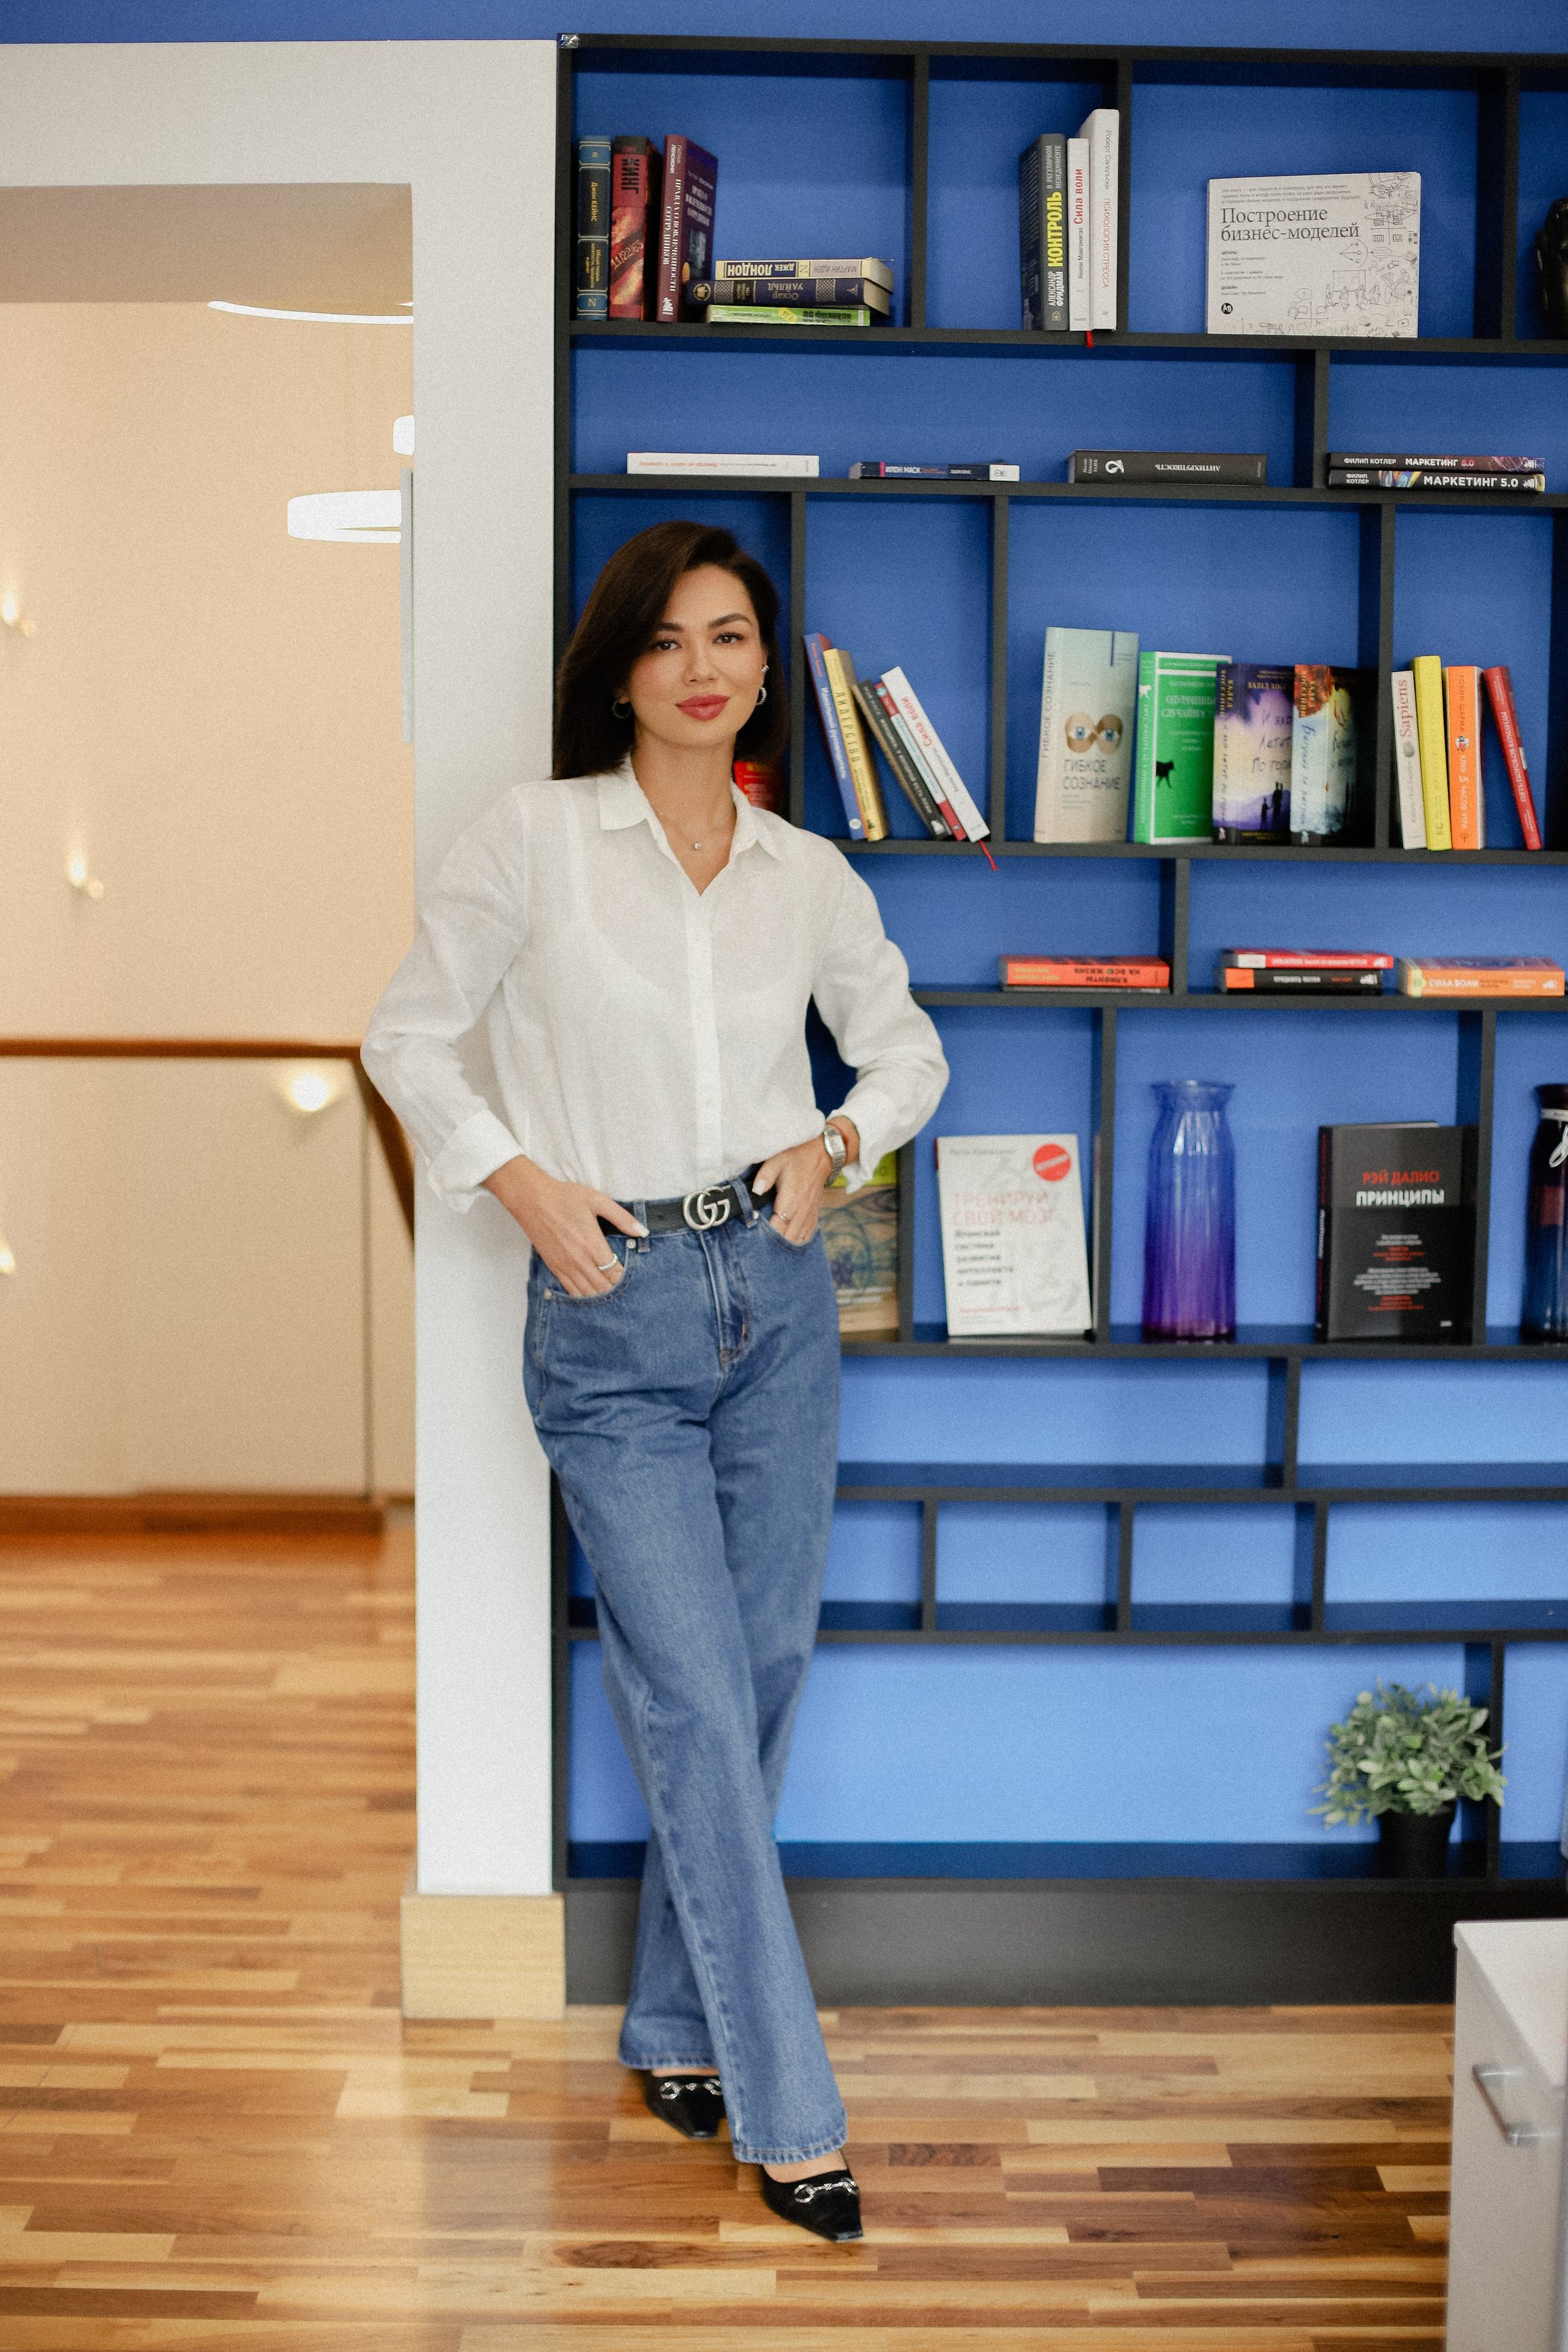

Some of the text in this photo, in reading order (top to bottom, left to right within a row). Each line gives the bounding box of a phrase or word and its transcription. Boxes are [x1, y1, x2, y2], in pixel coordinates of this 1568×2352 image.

[621, 159, 639, 194] КИНГ
[1073, 198, 1083, 225] Сила
[1221, 208, 1328, 227] Построение
[1047, 191, 1063, 267] КОНТРОЛЬ
[1221, 222, 1360, 241] бизнес-моделей
[727, 262, 795, 276] ДЖЕК ЛОНДОН
[767, 282, 804, 291] УАЙЛЬД
[1048, 271, 1057, 306] АЛЕКСАНДР
[772, 292, 799, 300] Оскар
[1404, 458, 1458, 467] МАРКЕТИНГ
[1423, 476, 1519, 488] МАРКЕТИНГ 5.0
[1046, 652, 1055, 712] СОЗНАНИЕ
[1247, 681, 1269, 690] ХАЛЕД
[1397, 679, 1414, 738] Sapiens
[836, 692, 860, 761] ЛИДЕРСТВО
[902, 696, 933, 747] Сила воли
[1064, 759, 1107, 773] ГИБКОЕ
[1063, 777, 1121, 790] СОЗНАНИЕ
[1458, 775, 1469, 783] 5
[1362, 1169, 1439, 1185] РЭЙ ДАЛИО
[1355, 1189, 1445, 1207] ПРИНЦИПЫ
